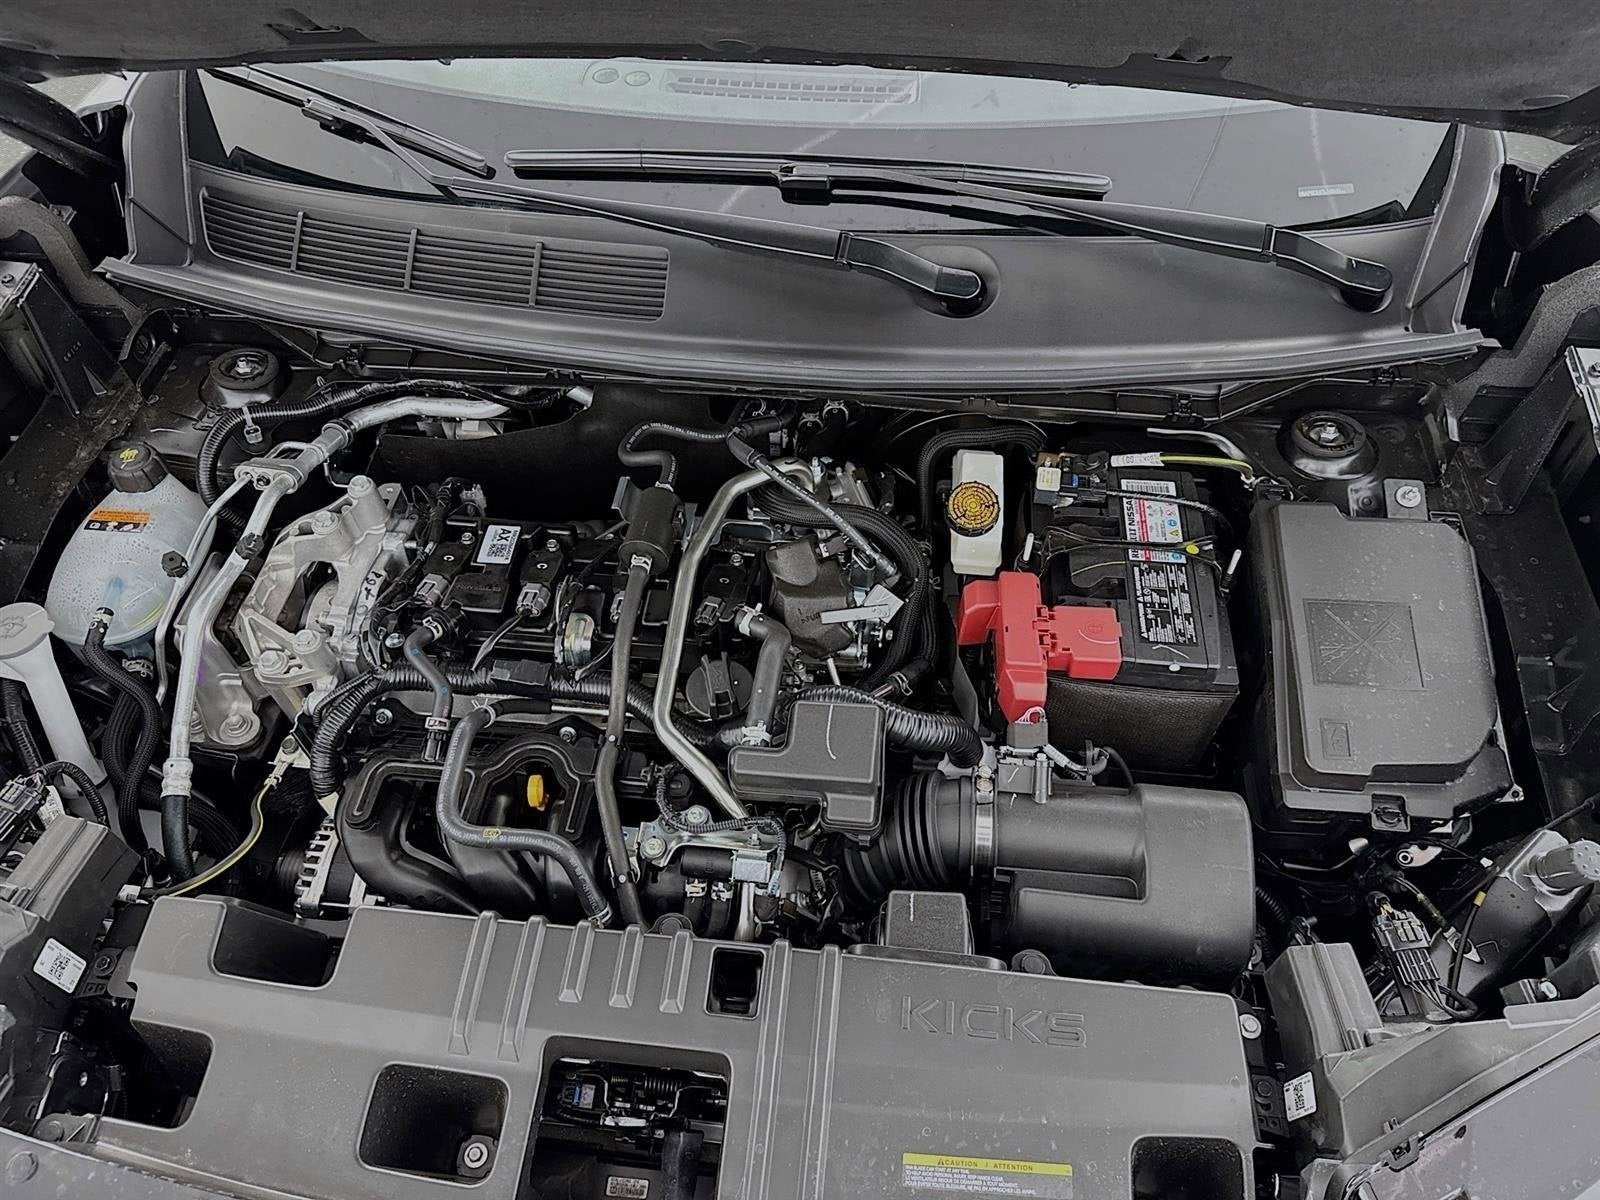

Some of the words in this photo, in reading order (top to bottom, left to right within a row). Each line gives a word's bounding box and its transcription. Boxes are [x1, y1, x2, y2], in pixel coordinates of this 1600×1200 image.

[497, 528, 512, 542] AX
[902, 995, 1087, 1048] KICKS
[944, 1160, 978, 1168] CAUTION
[993, 1162, 1034, 1171] ATTENTION
